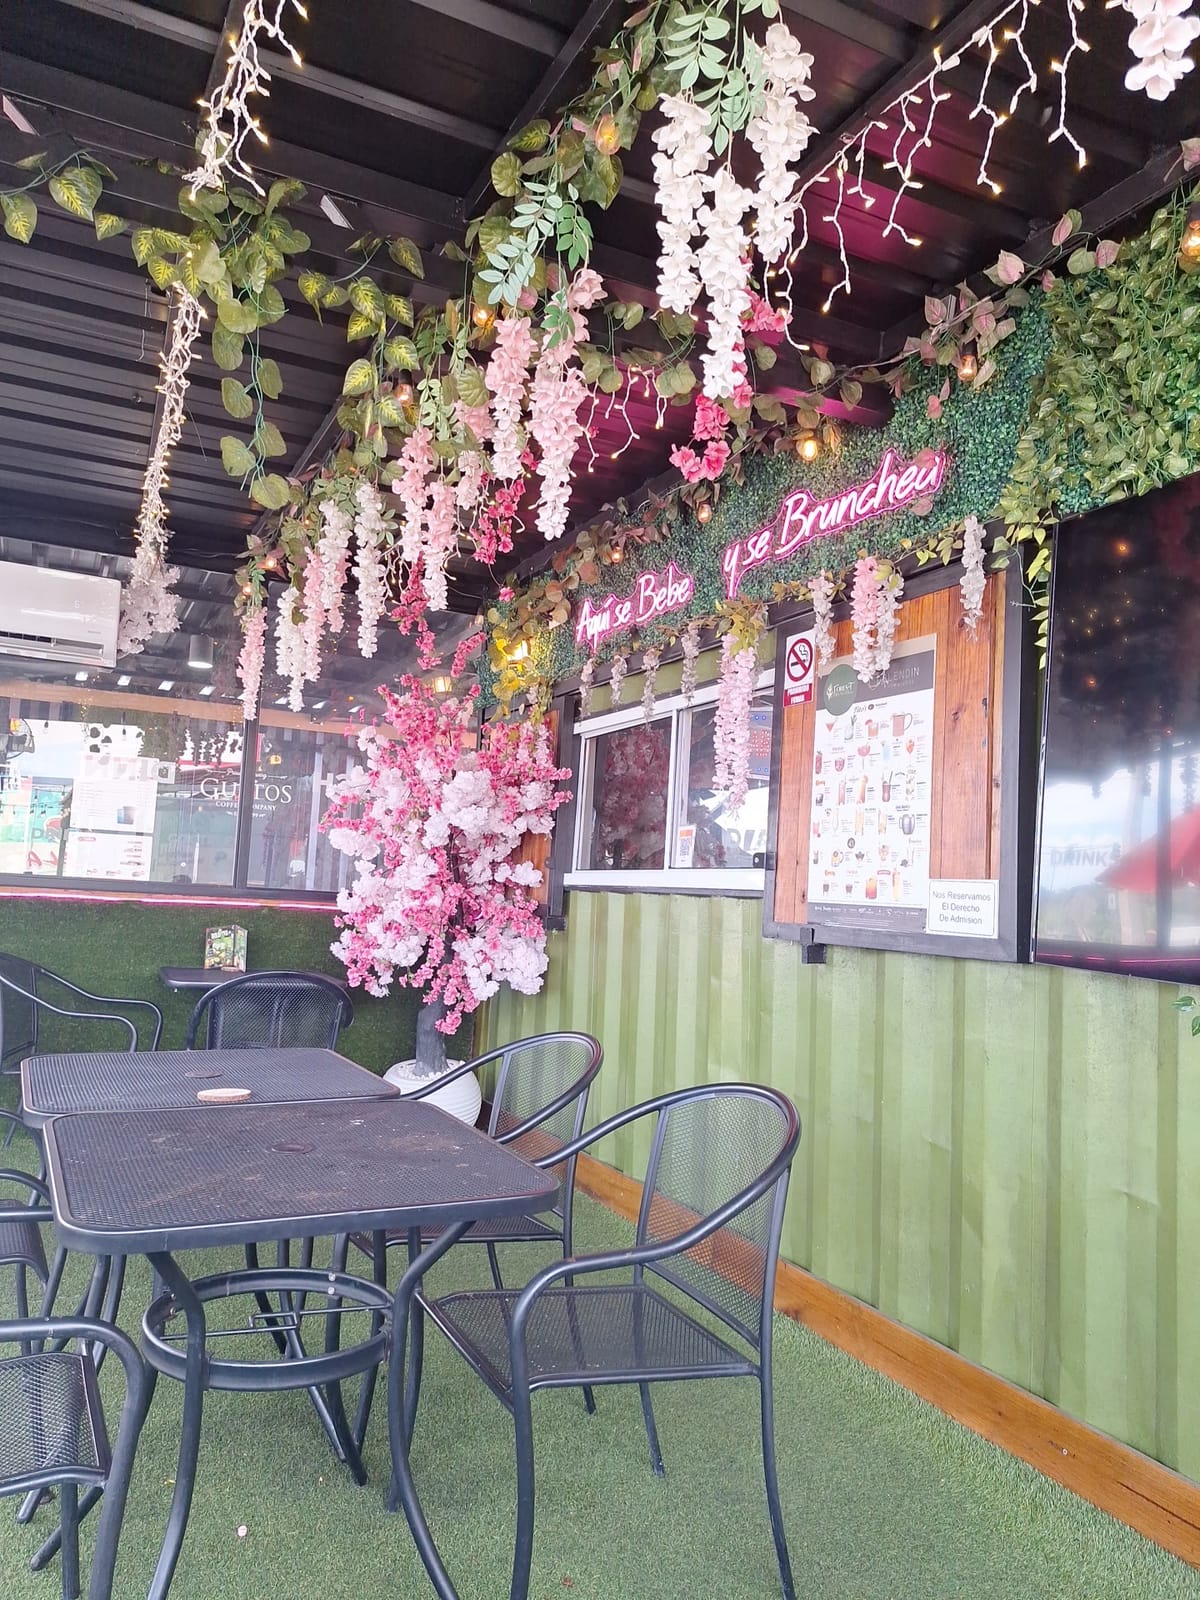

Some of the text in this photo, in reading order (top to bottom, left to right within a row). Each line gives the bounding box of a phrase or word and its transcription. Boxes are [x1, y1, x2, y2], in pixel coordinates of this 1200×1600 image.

[723, 543, 740, 598] y
[743, 530, 771, 566] se
[613, 601, 632, 627] se
[636, 565, 691, 622] Bebe
[200, 777, 293, 804] GUTOS
[932, 890, 992, 902] Nos Reservamos
[941, 902, 980, 913] El Derecho
[939, 913, 948, 922] De
